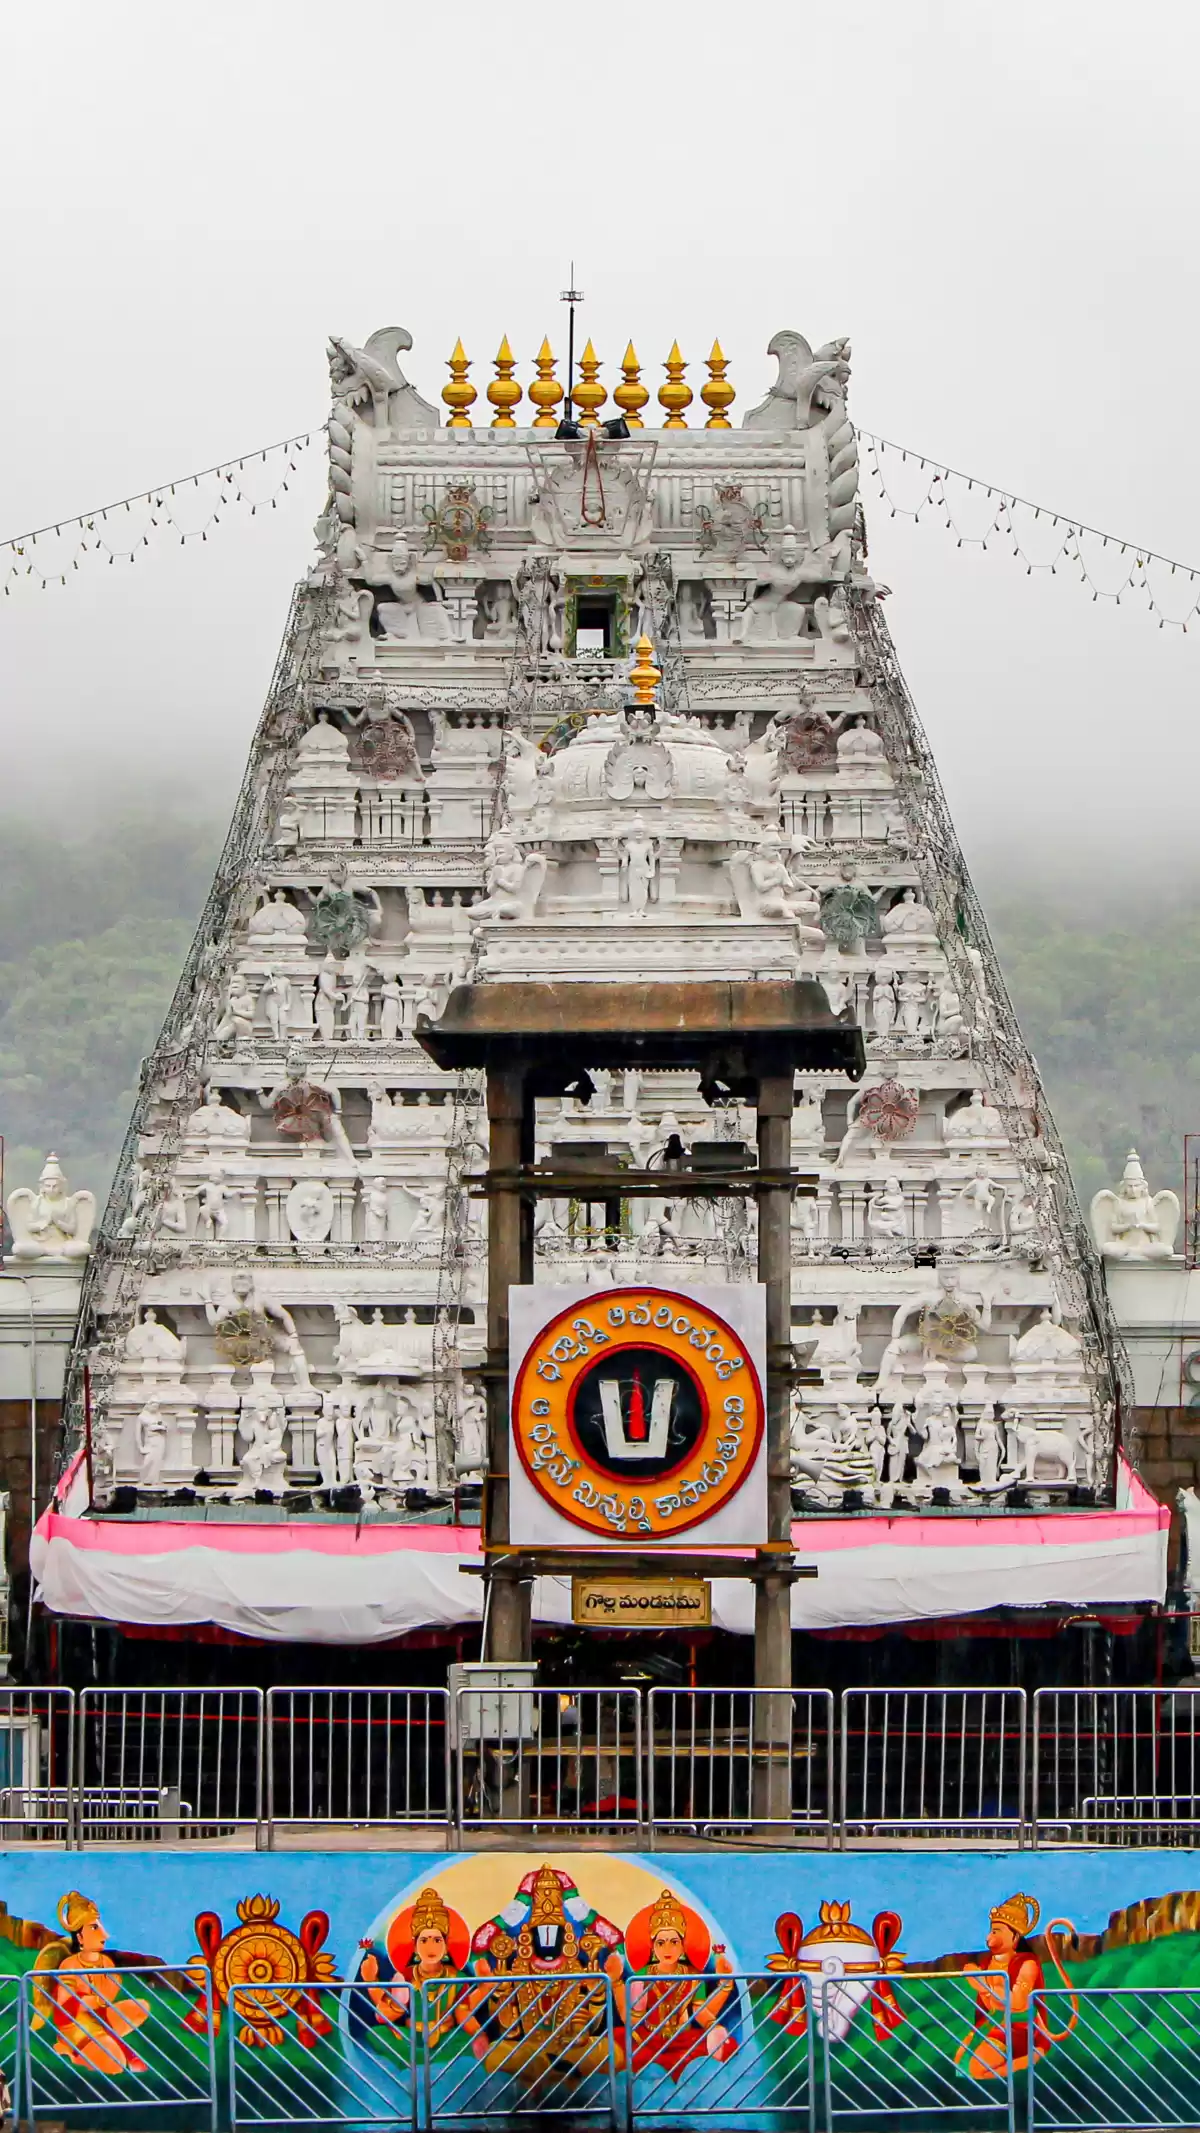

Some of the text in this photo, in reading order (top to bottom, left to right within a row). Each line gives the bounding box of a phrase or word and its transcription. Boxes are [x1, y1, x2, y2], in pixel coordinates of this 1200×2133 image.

[607, 1299, 744, 1381] ఆచరించండి
[531, 1398, 550, 1415] ఆ
[573, 1480, 652, 1531] మిమ్మల్ని
[654, 1395, 745, 1517] కాపాడుతుంది
[619, 1594, 701, 1610] మండపము
